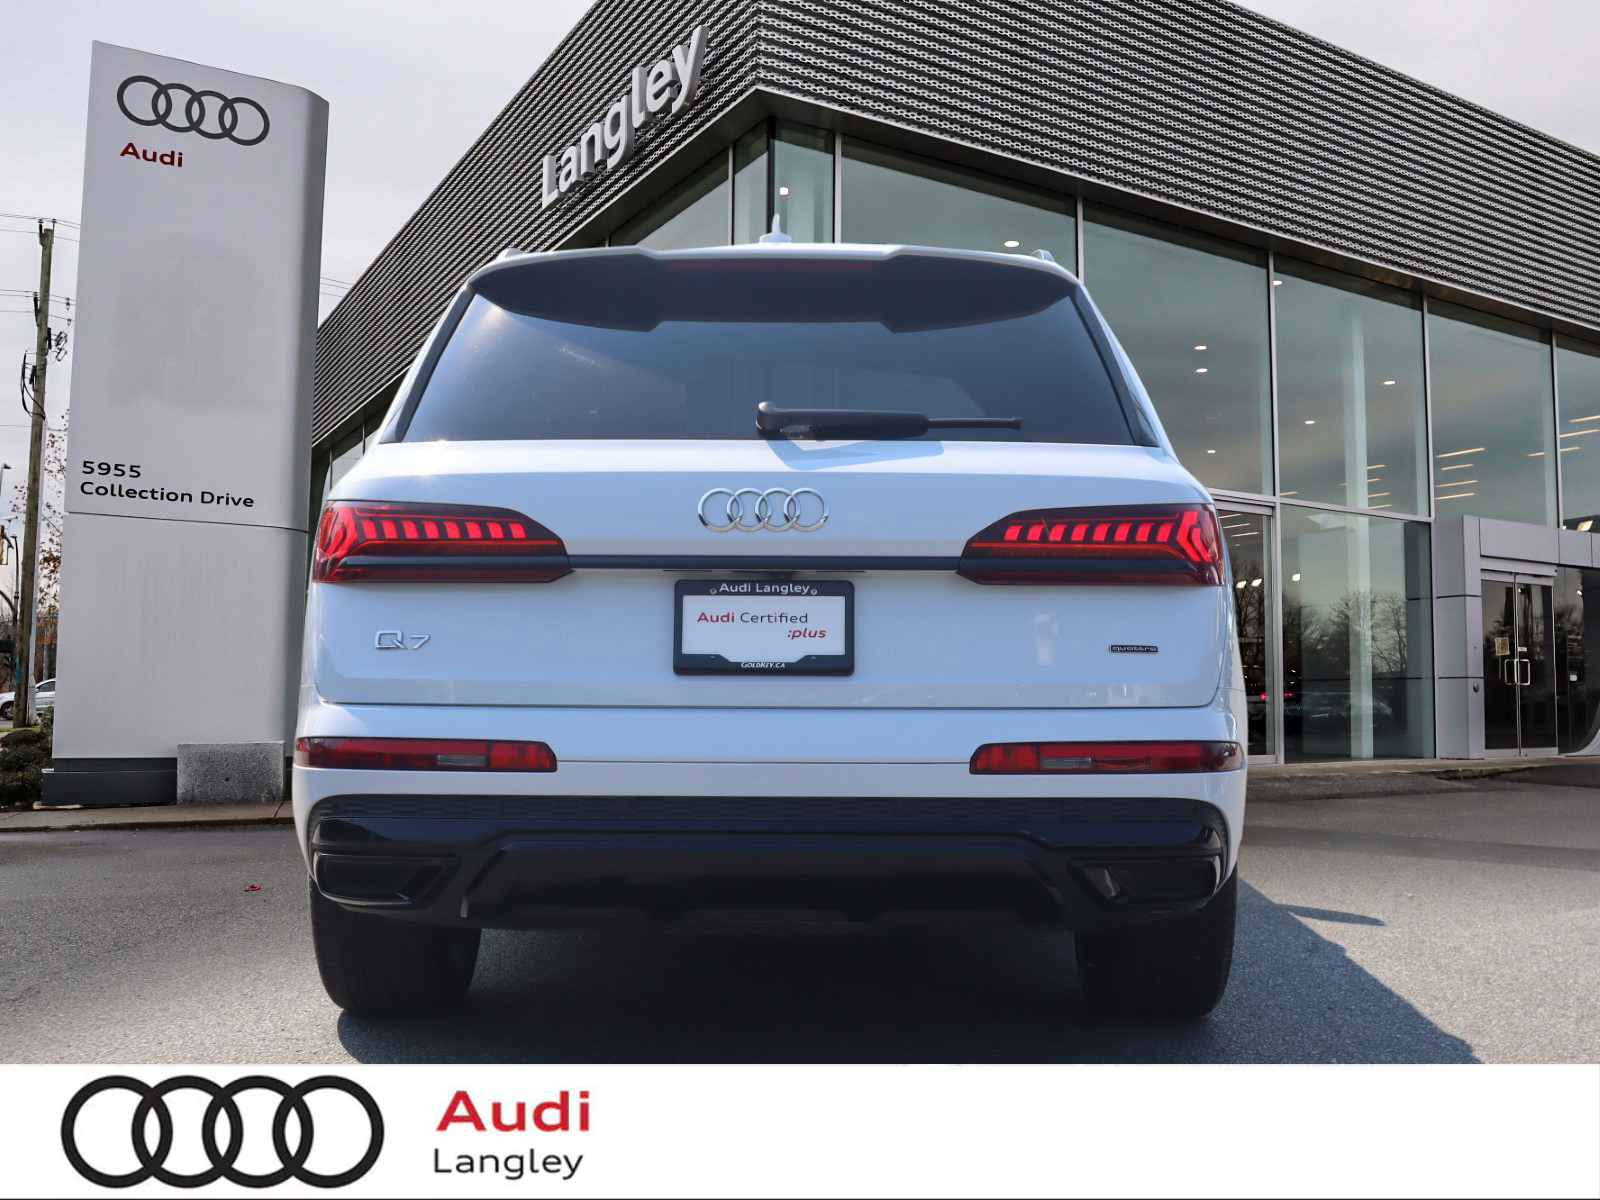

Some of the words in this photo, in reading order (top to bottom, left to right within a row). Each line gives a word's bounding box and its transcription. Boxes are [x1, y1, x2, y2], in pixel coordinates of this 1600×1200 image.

[542, 25, 710, 209] Langley
[120, 142, 183, 168] Audi
[81, 460, 141, 479] 5955
[80, 481, 193, 503] Collection
[200, 491, 255, 508] Drive
[719, 583, 751, 593] Audi
[755, 583, 810, 595] Langley
[697, 611, 735, 623] Audi
[740, 612, 809, 624] Certified
[374, 629, 431, 650] Q7
[787, 628, 827, 640] :plus
